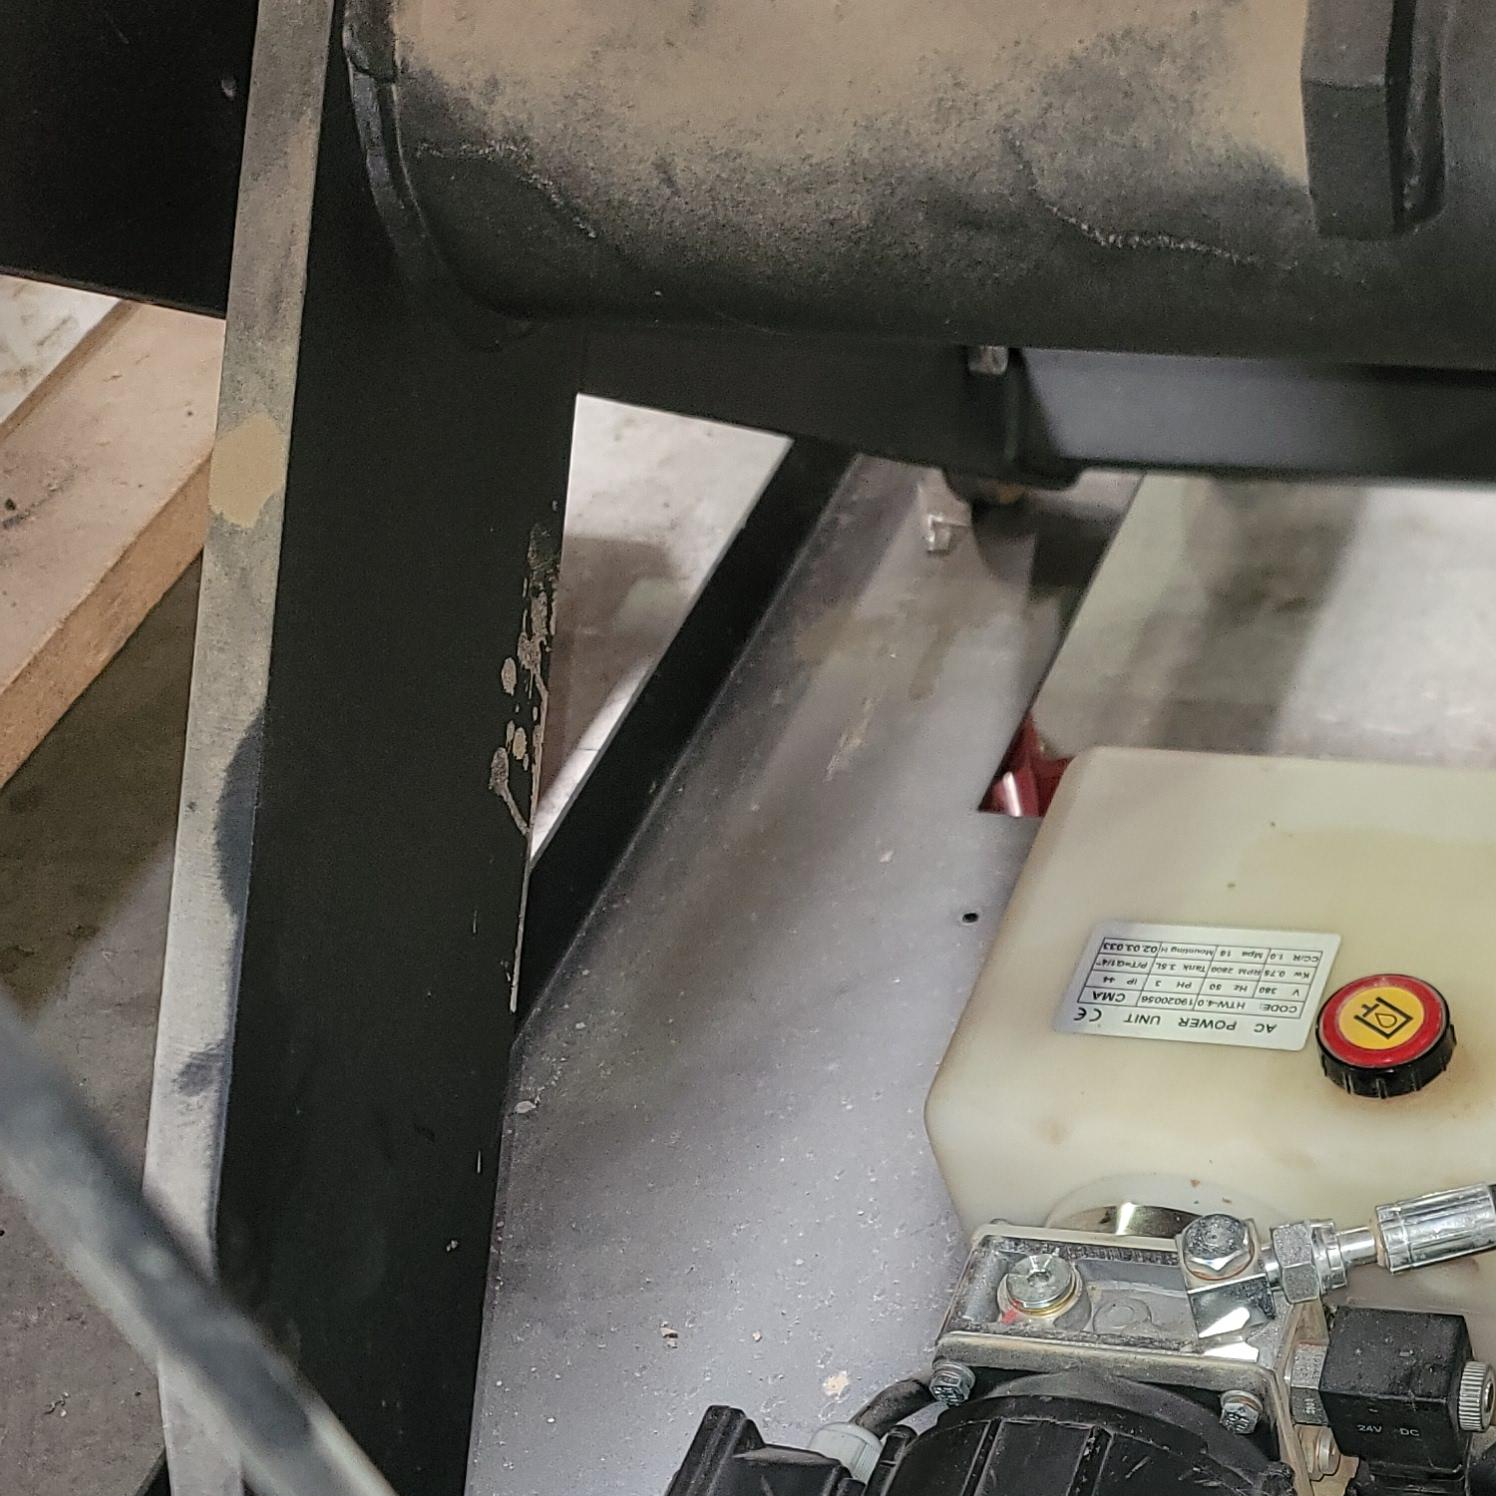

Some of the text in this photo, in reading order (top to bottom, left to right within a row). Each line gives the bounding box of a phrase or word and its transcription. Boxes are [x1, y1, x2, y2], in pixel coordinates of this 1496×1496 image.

[1170, 946, 1215, 956] Mounting
[1269, 953, 1284, 961] 1.0
[1155, 962, 1176, 970] 3.5L
[1183, 964, 1206, 972] Tank
[1210, 966, 1234, 974] 2800
[1238, 968, 1262, 976] RPM
[1263, 969, 1286, 978] 0.75
[1293, 971, 1310, 979] Kw
[1176, 981, 1192, 989] PH
[1208, 983, 1222, 991] 50
[1233, 984, 1248, 992] Hz
[1258, 986, 1278, 995] 380
[1291, 988, 1300, 997] V
[1092, 991, 1126, 1002] CMA
[1141, 995, 1194, 1005] 19020056
[1197, 999, 1246, 1009] HTW-4.0
[1123, 1013, 1277, 1034] AC POWER UNIT
[1356, 1424, 1420, 1437] 24V DC
